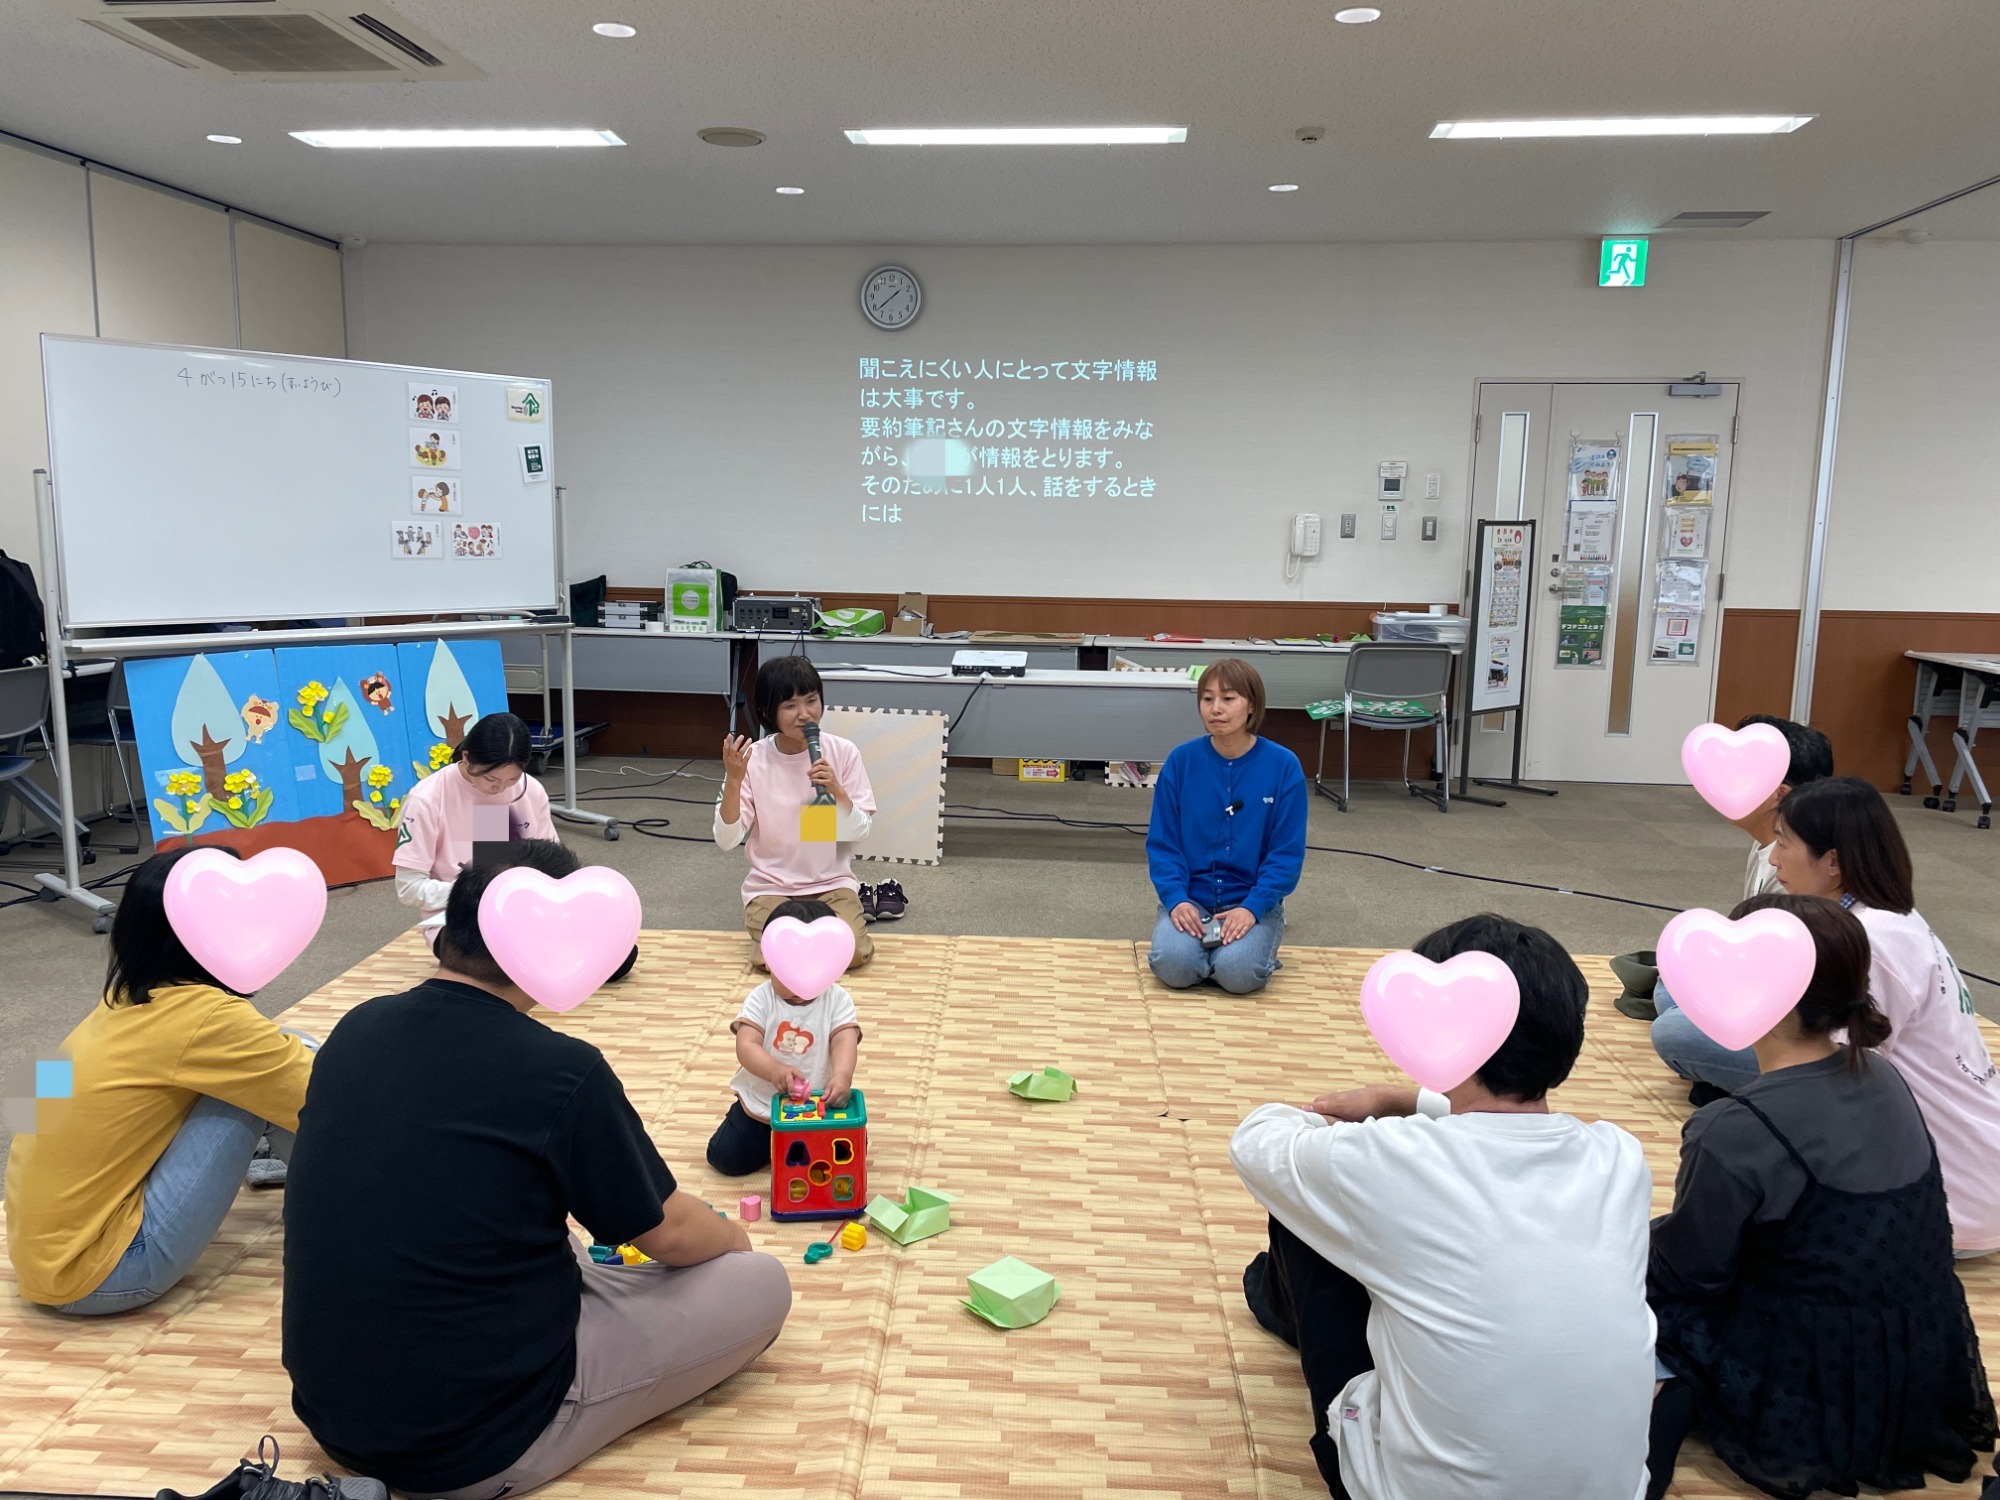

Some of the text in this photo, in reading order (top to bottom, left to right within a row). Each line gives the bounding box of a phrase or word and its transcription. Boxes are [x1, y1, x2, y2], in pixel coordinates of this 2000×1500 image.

[859, 357, 1158, 382] 聞こえにくい人にとって文字情報
[860, 387, 975, 410] は大事です。
[861, 416, 1153, 440] 要約筆記さんの文字情報をみな
[861, 504, 902, 524] には
